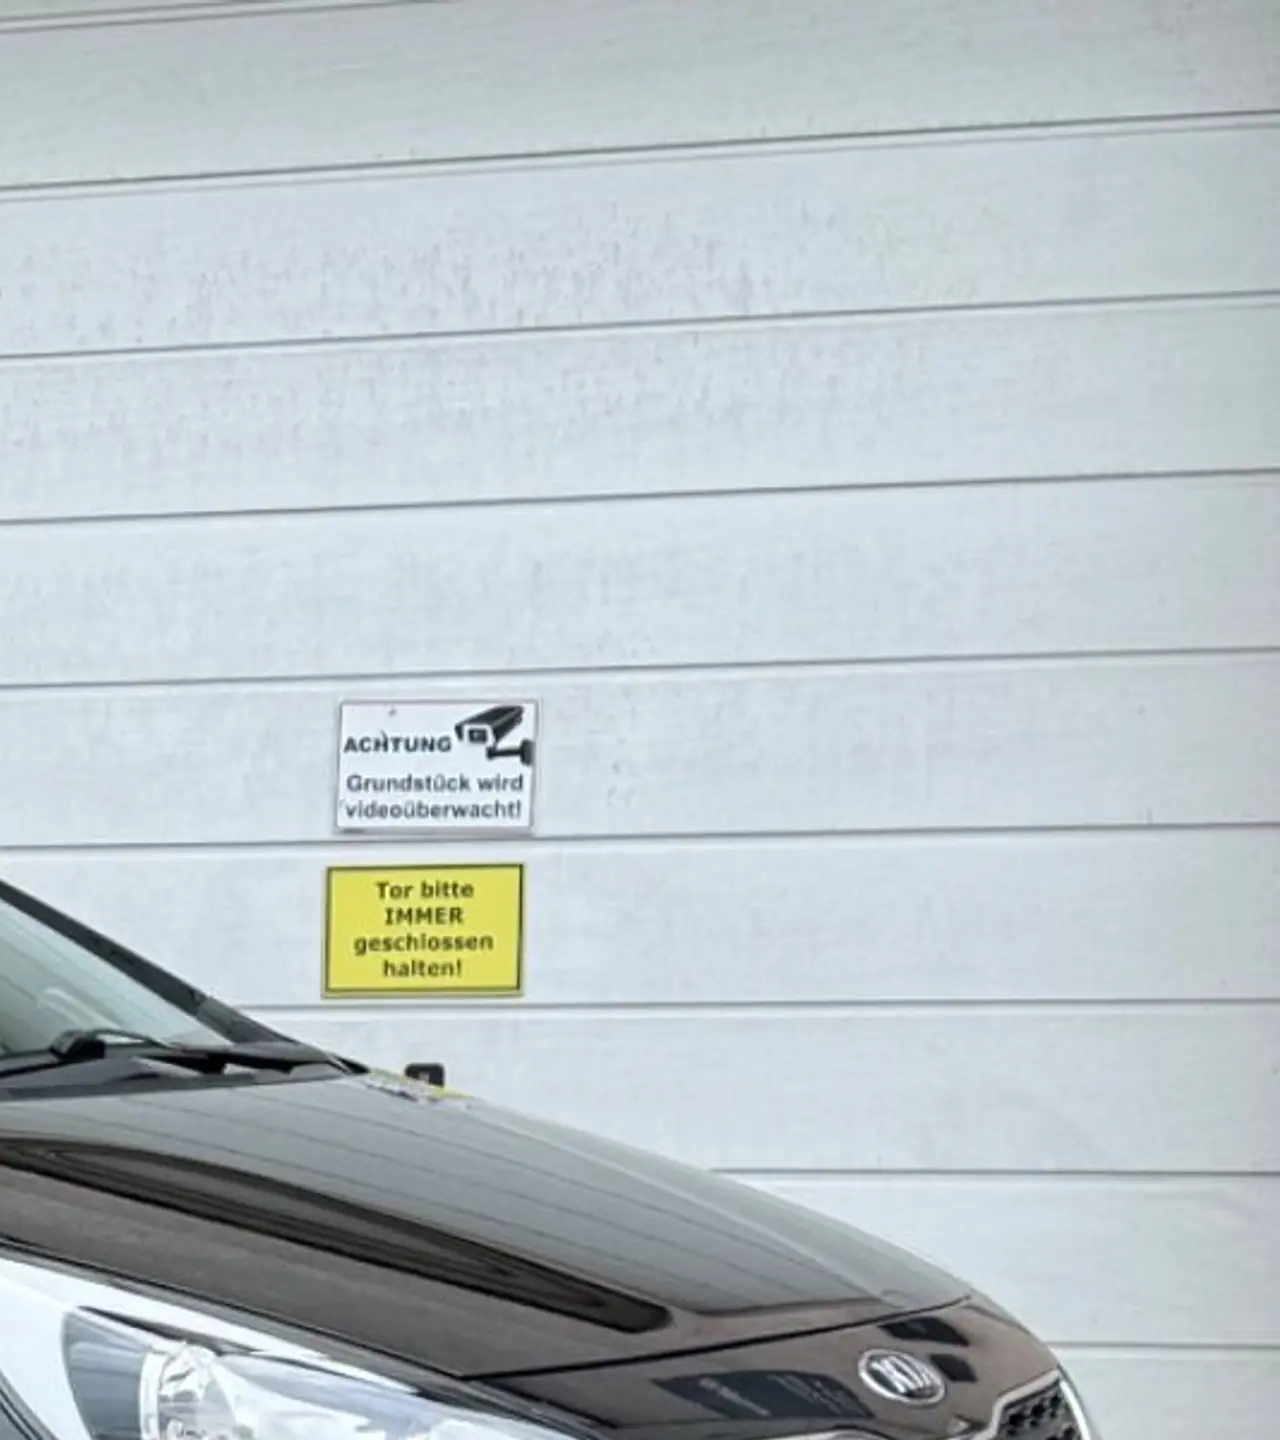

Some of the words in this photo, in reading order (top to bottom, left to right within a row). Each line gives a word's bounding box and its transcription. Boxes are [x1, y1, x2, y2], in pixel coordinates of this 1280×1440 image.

[343, 736, 453, 754] ACHTUNG
[346, 773, 471, 793] Grundstück
[477, 772, 524, 792] wird
[345, 799, 523, 819] videoüberwacht!
[375, 880, 414, 899] Tor
[420, 879, 475, 899] bitte
[384, 906, 465, 926] IMMER
[353, 932, 494, 956] geschlossen
[382, 957, 462, 978] halten!
